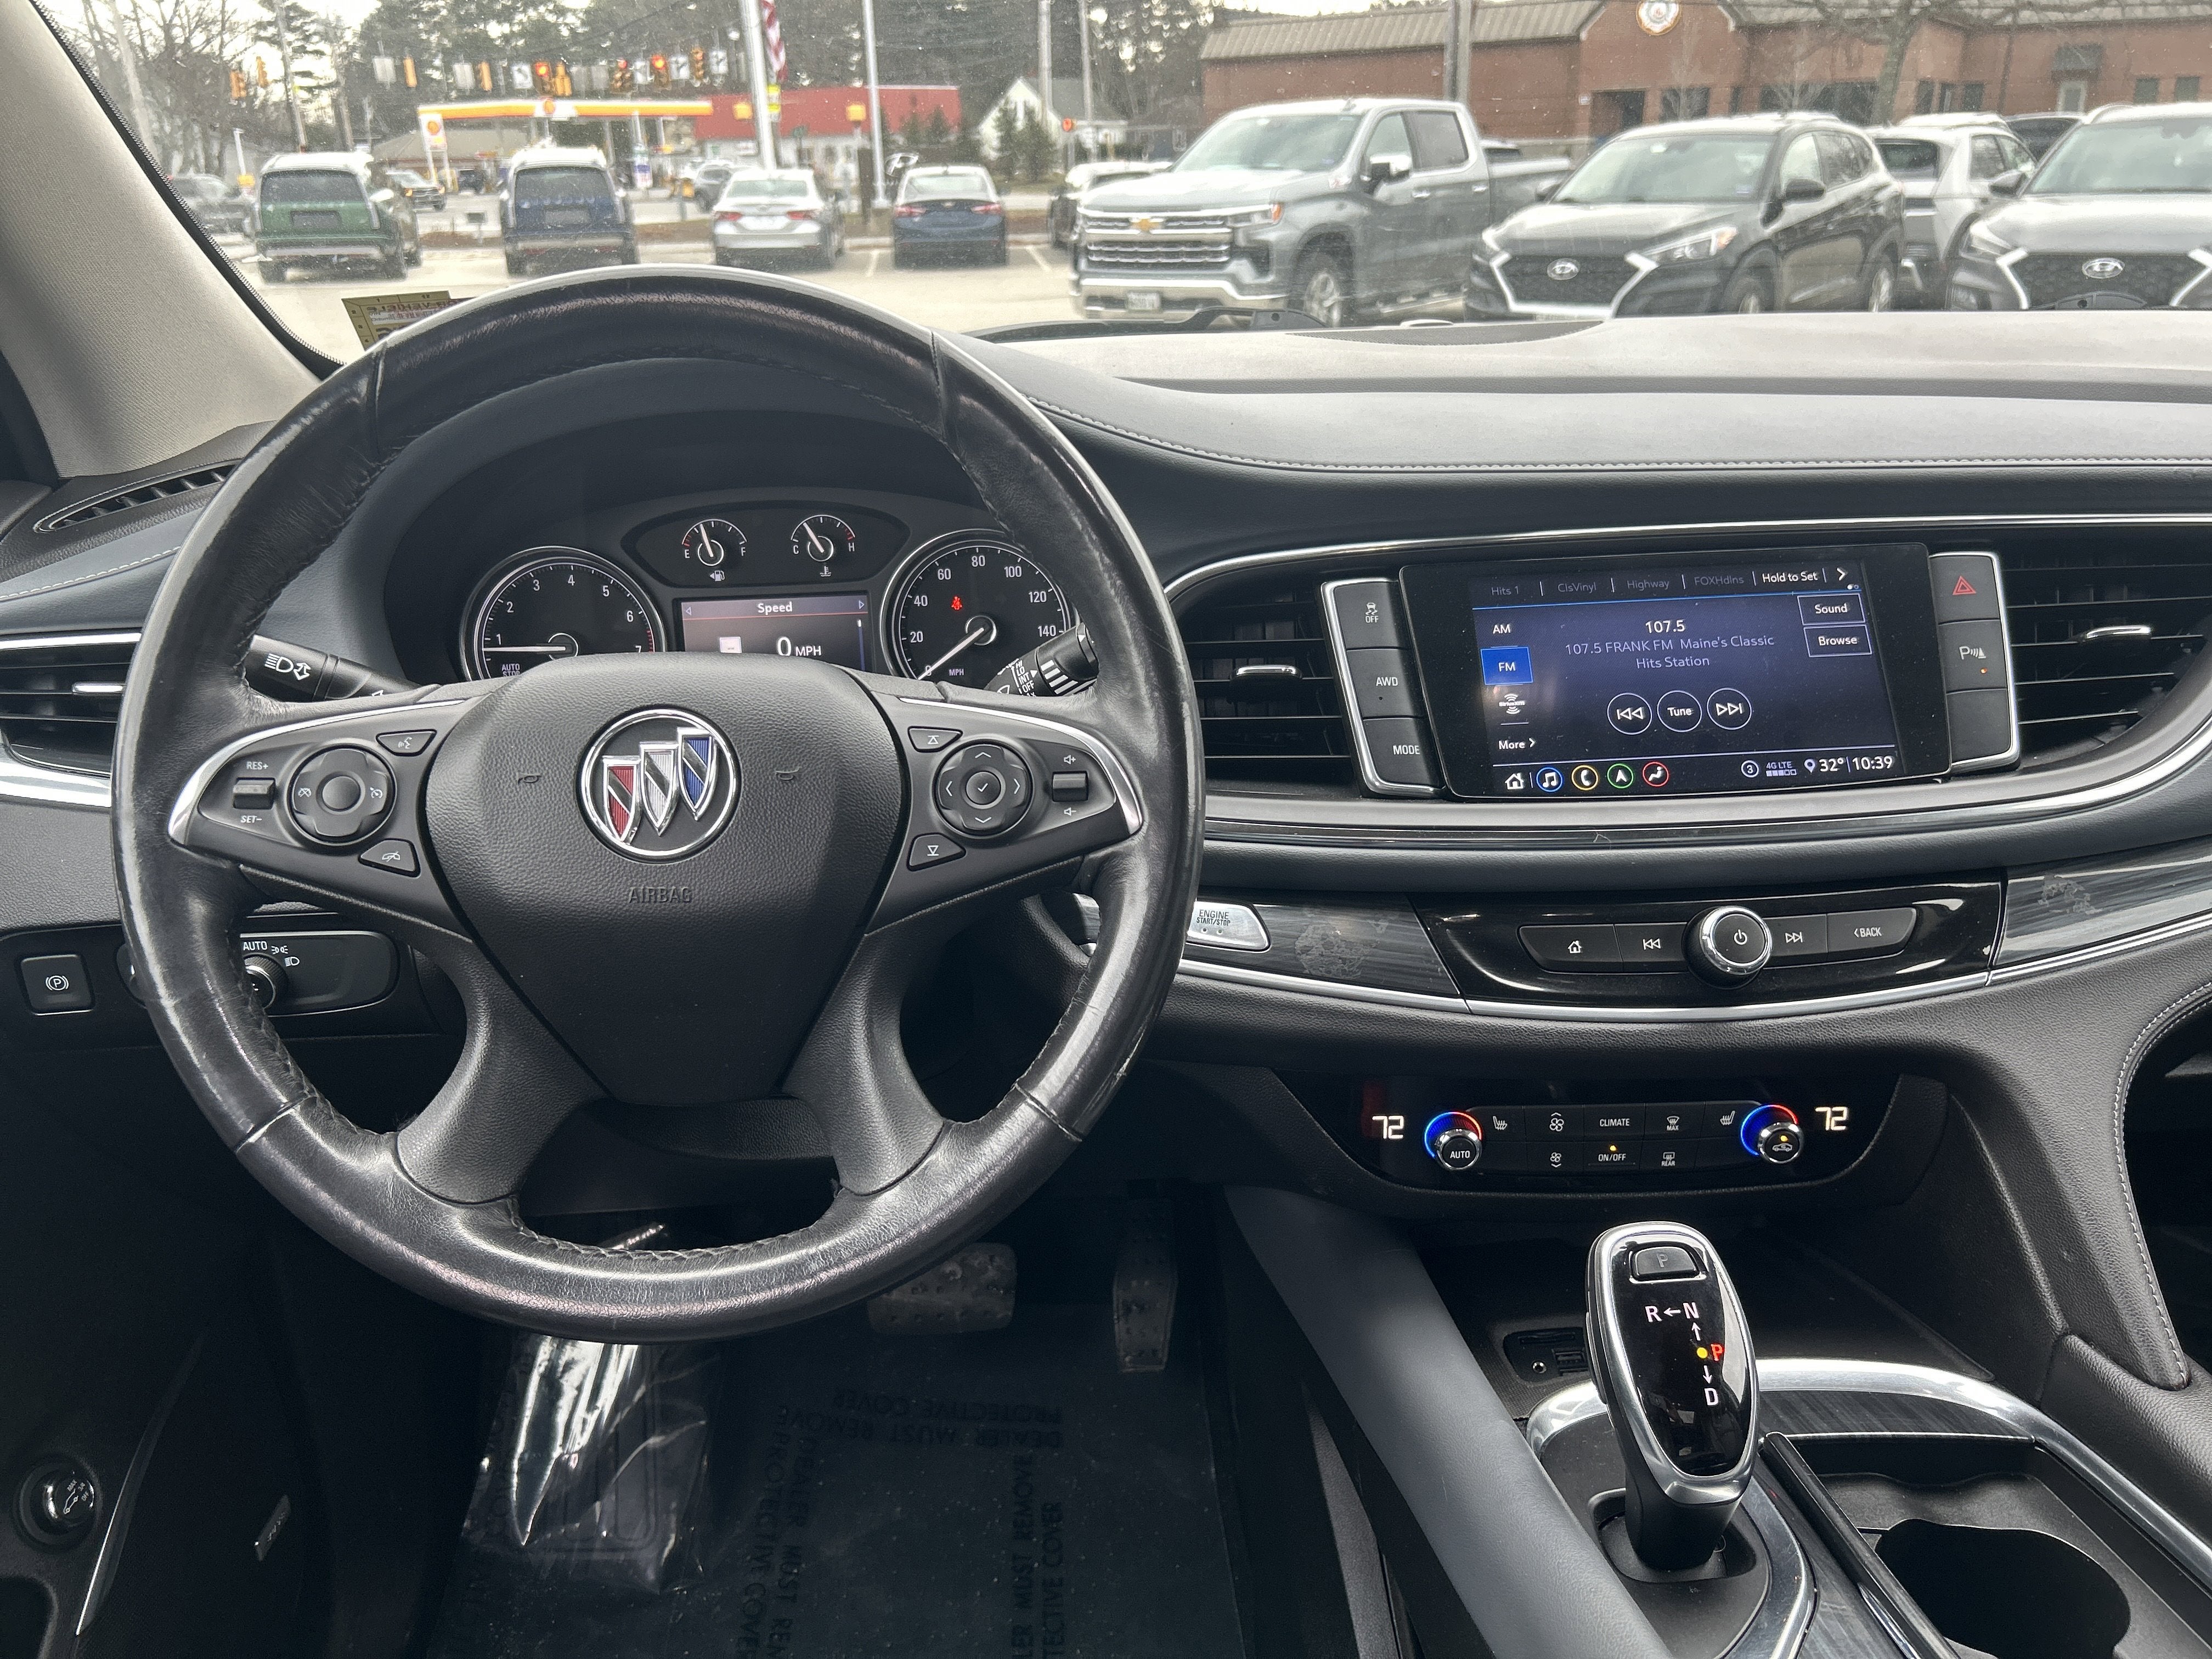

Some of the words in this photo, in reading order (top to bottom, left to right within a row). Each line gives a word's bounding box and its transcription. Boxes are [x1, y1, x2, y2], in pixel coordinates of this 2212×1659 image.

[684, 549, 690, 558] E
[741, 547, 746, 556] F
[793, 545, 799, 555] C
[848, 543, 855, 552] H
[971, 555, 985, 567] 80
[937, 568, 951, 580] 60
[1004, 566, 1022, 578] 100
[1762, 572, 1786, 583] Hold
[1787, 573, 1798, 583] to
[1801, 571, 1818, 582] Set
[533, 579, 540, 591] 3
[567, 574, 575, 586] 4
[1627, 580, 1669, 591] Highway
[602, 585, 610, 597] 5
[1491, 586, 1511, 596] Hits
[1515, 585, 1520, 595] 1
[1558, 582, 1597, 593] ClsVinyl
[913, 595, 928, 607] 40
[1028, 591, 1047, 603] 120
[506, 601, 514, 613] 2
[758, 602, 793, 616] Speed
[1814, 603, 1848, 614] Sound
[627, 610, 634, 622] 6
[1365, 615, 1379, 624] OFF
[1037, 625, 1057, 637] 140
[1493, 624, 1511, 634] AM
[1645, 620, 1686, 634] 107.5
[496, 633, 503, 645] 1
[910, 631, 923, 643] 20
[1818, 635, 1858, 646] Browse
[777, 636, 792, 656] 0
[795, 646, 821, 657] MPH
[1565, 642, 1600, 655] 107.5
[1605, 640, 1650, 653] FRANK
[1653, 639, 1673, 651] FM
[1680, 636, 1728, 650] Maine's
[1730, 635, 1775, 647] Classic
[501, 663, 520, 672] AUTO
[1015, 660, 1023, 669] HI
[1498, 662, 1516, 672] FM
[1636, 658, 1662, 669] Hits
[1664, 656, 1710, 668] Station
[1016, 666, 1025, 676] LO
[1018, 672, 1030, 685] INT
[1375, 676, 1398, 687] AWD
[1022, 680, 1034, 693] OFF
[1667, 707, 1692, 716] Tune
[1392, 745, 1421, 755] MODE
[1498, 740, 1525, 750] More
[246, 761, 269, 770] RES+
[1766, 761, 1777, 770] 4G
[1779, 761, 1792, 769] LTE
[1819, 757, 1844, 772] 32°
[1853, 755, 1894, 770] 10:39
[1746, 765, 1753, 773] 3
[628, 887, 693, 904] AIRBAG
[1199, 909, 1229, 920] ENGINE
[1196, 917, 1231, 927] START/STOP
[1859, 927, 1882, 938] BACK
[243, 941, 268, 951] AUTO
[1599, 1118, 1630, 1127] CLIMATE
[1814, 1107, 1849, 1131] 72
[1372, 1115, 1404, 1139] 72
[1450, 1150, 1470, 1159] AUTO
[1598, 1153, 1627, 1163] ON/OFF
[1656, 1253, 1668, 1268] P
[1645, 1305, 1662, 1322] R
[1683, 1302, 1700, 1319] N
[1711, 1344, 1724, 1361] P
[1704, 1387, 1718, 1406] D
